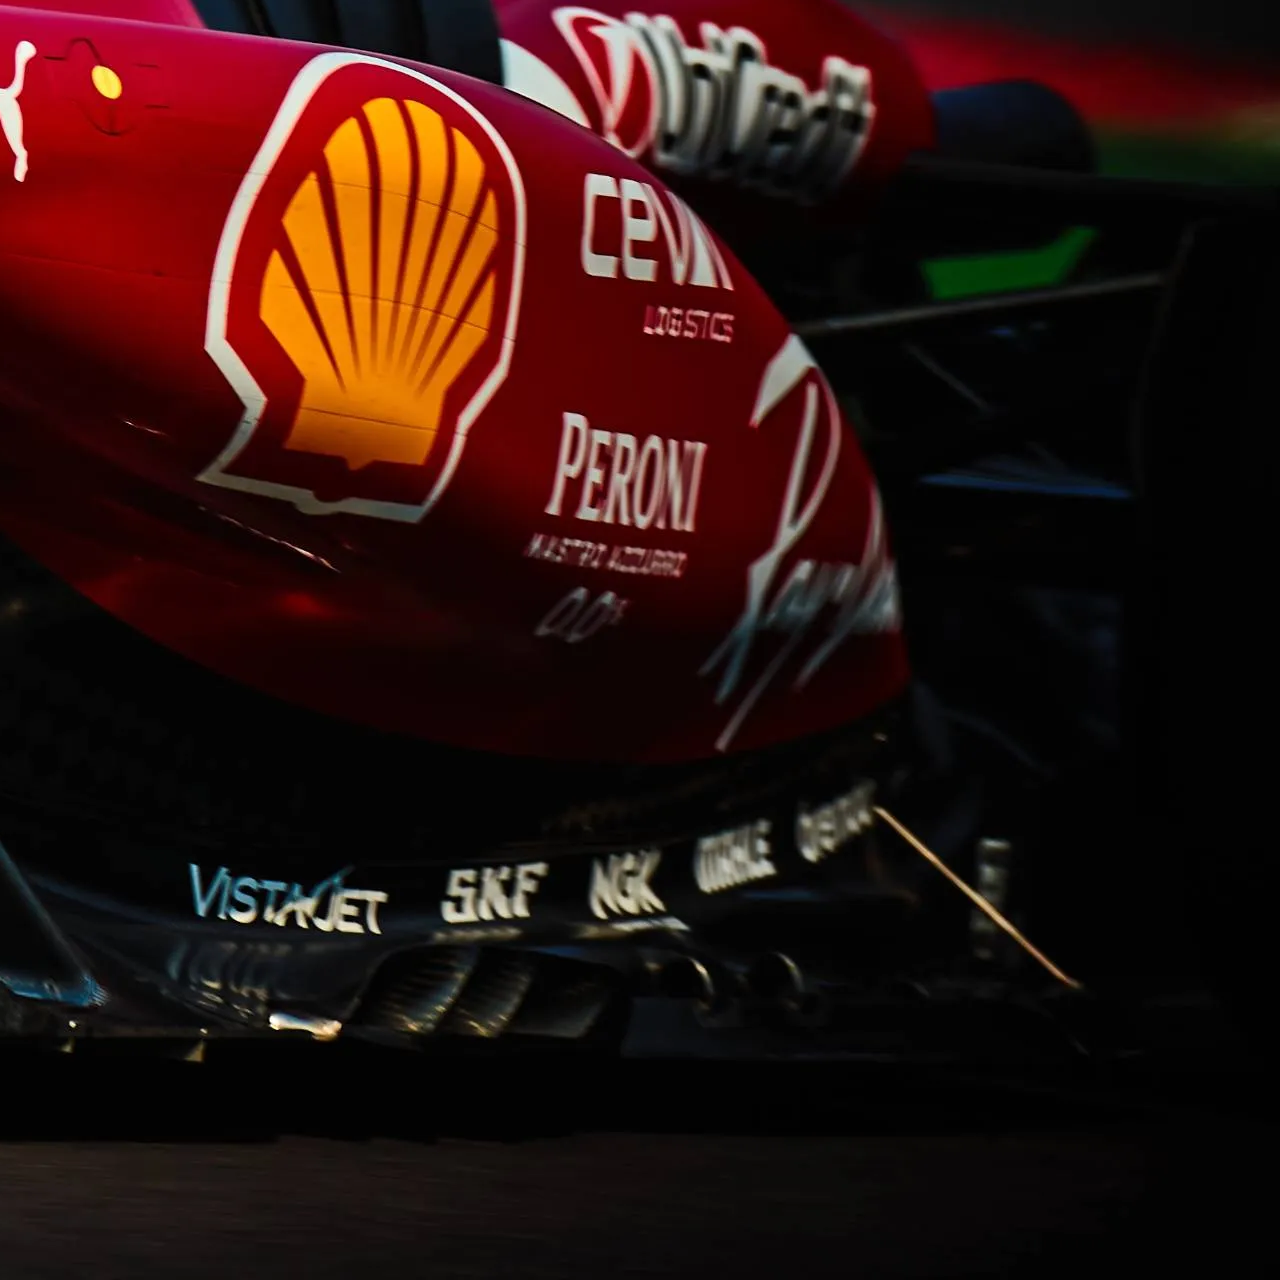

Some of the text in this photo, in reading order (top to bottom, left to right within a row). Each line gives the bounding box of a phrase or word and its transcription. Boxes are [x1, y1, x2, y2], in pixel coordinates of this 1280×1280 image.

[545, 411, 707, 533] PERONI
[441, 861, 548, 924] SKF
[589, 847, 666, 920] NGK
